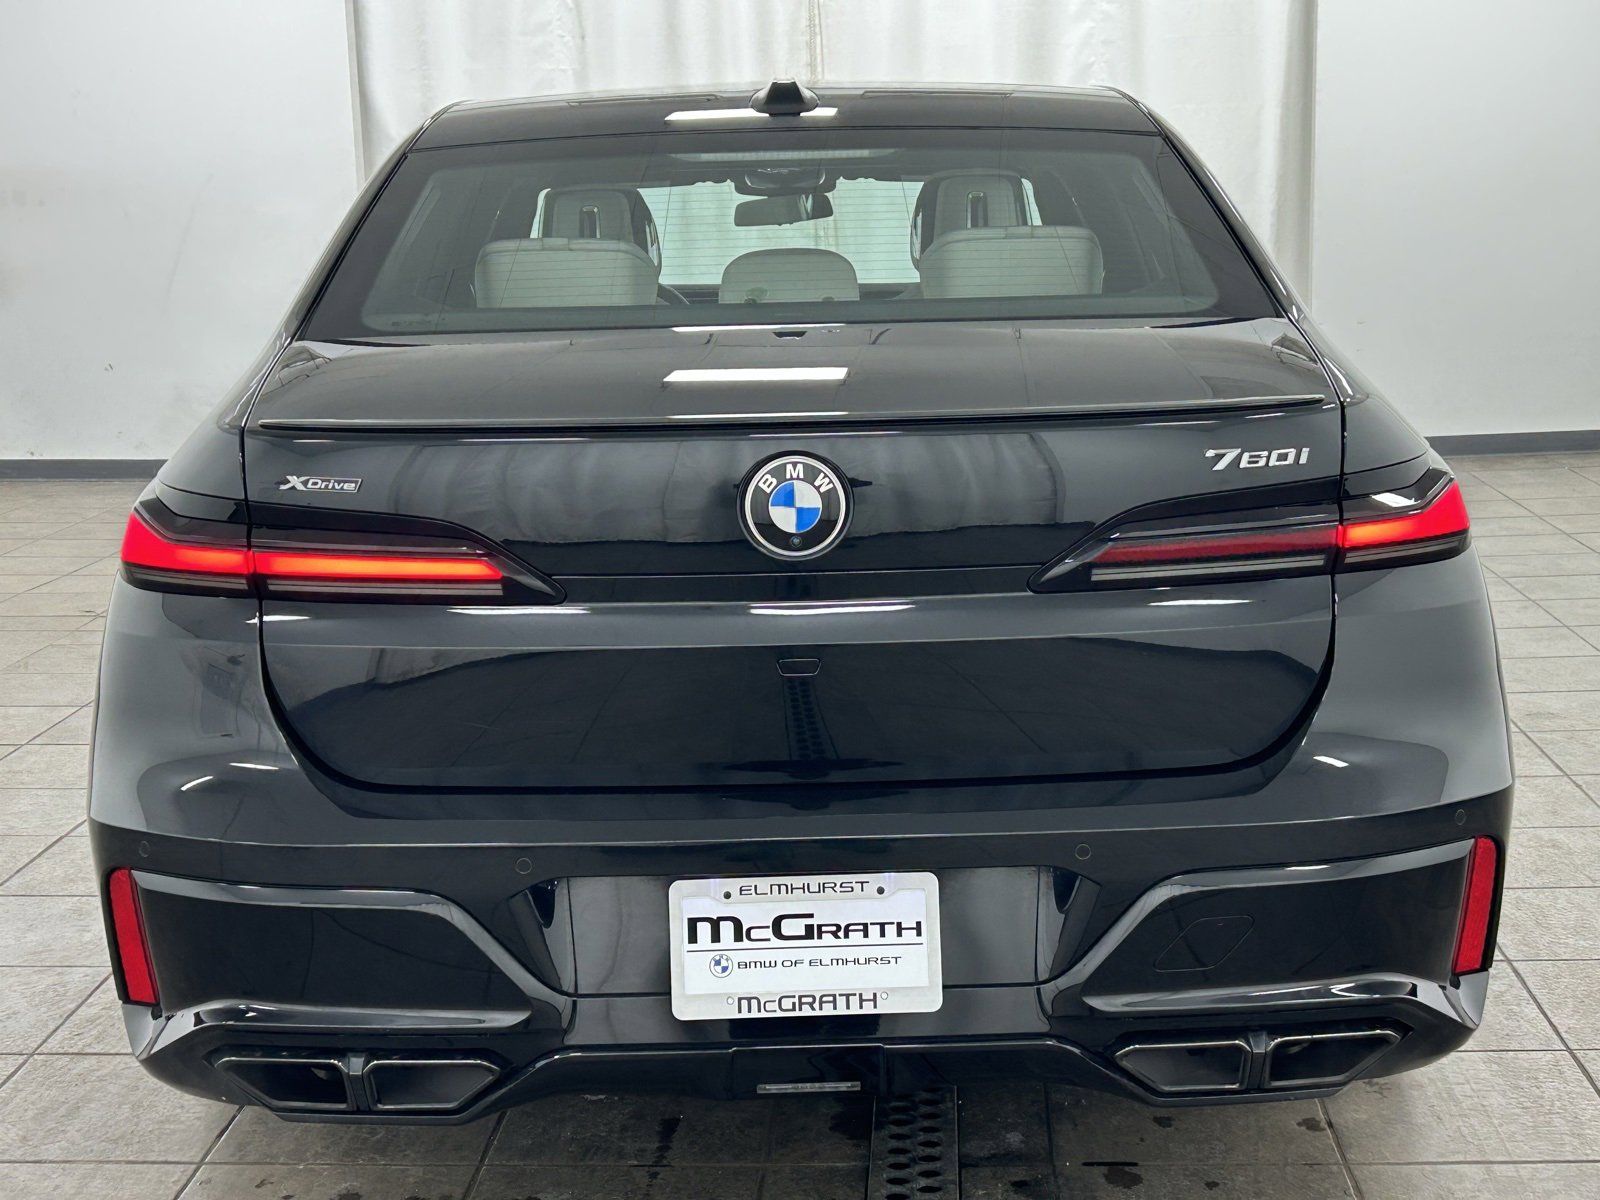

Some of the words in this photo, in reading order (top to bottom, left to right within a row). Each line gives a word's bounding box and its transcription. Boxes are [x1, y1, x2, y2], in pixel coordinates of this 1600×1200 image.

[1204, 447, 1310, 471] 760i
[757, 463, 834, 494] BMW
[739, 881, 870, 896] ELMHURST
[737, 960, 778, 969] BMW
[781, 958, 805, 968] OF
[808, 956, 902, 967] ELMHURST
